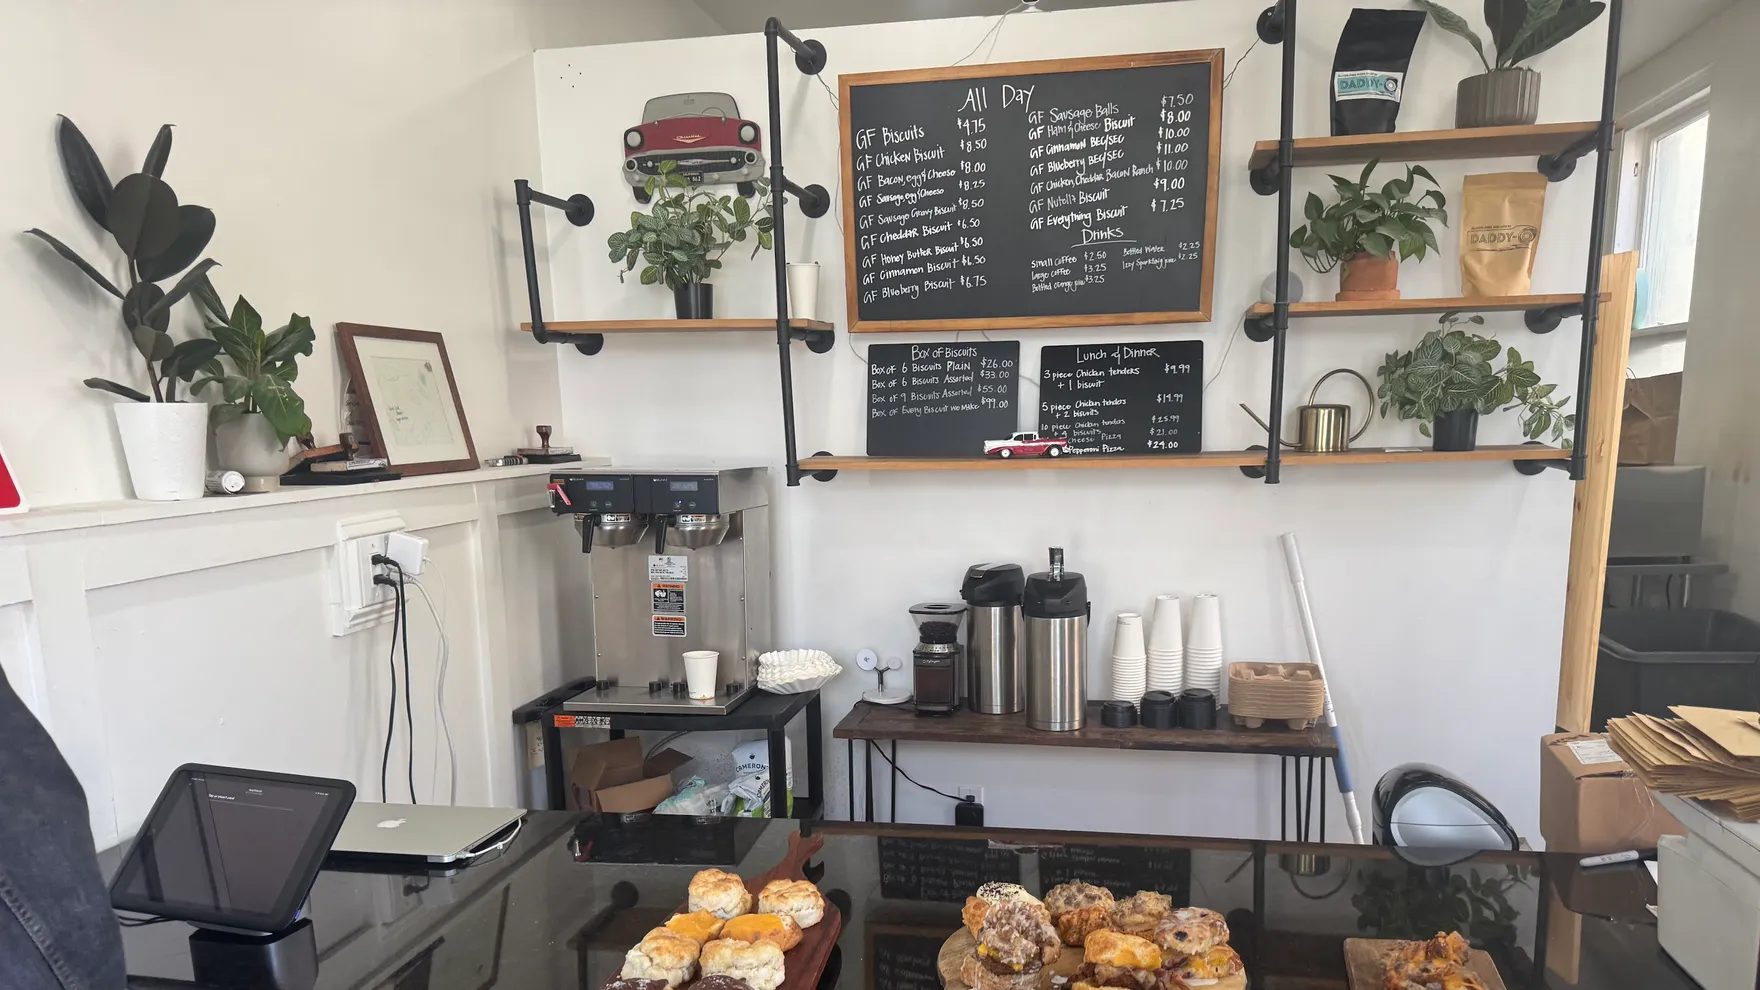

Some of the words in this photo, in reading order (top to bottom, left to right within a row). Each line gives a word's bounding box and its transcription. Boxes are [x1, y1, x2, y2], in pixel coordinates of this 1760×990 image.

[957, 86, 988, 112] All
[1002, 84, 1035, 113] Day
[1028, 110, 1045, 125] GF
[1050, 107, 1093, 124] Sausage
[1095, 102, 1119, 119] Balls
[1161, 93, 1194, 108] $7.50
[856, 128, 876, 150] GF
[882, 124, 925, 147] Biscuits
[956, 117, 986, 136] $4.75
[1028, 125, 1045, 140] GF
[1047, 124, 1067, 138] Ham
[1074, 119, 1101, 133] Cheese
[1104, 113, 1135, 132] Biscuit
[1160, 108, 1191, 124] $8.00
[1029, 144, 1044, 159] GF
[1158, 126, 1190, 140] $10.00
[856, 154, 873, 172] GF
[913, 144, 945, 164] Biscuit
[959, 138, 987, 153] $8.50
[1030, 162, 1044, 177] GF
[1047, 158, 1086, 175] Blueberry
[1156, 142, 1188, 155] $11.00
[857, 175, 873, 192] GF
[960, 160, 986, 174] $8.00
[1030, 181, 1044, 195] GF
[1132, 162, 1154, 177] Ranch
[1155, 157, 1188, 172] $10.00
[858, 195, 873, 208] GF
[958, 178, 986, 191] $8.25
[1028, 199, 1044, 214] GF
[1078, 187, 1110, 205] Biscuit
[1153, 177, 1185, 191] $9.00
[859, 215, 875, 230] GF
[877, 212, 910, 226] Sausage
[910, 207, 933, 220] Gravy
[934, 202, 957, 215] Biscuit
[958, 197, 985, 210] $8.50
[1030, 217, 1044, 230] GF
[1047, 211, 1092, 230] Everything
[1096, 205, 1128, 222] Biscuit
[1150, 197, 1185, 212] $7.25
[860, 233, 878, 250] GF
[922, 220, 953, 237] Biscuit
[957, 217, 981, 230] $6.50
[1081, 226, 1124, 245] Drinks
[862, 253, 877, 269] GF
[880, 253, 905, 267] Honey
[935, 241, 959, 255] Biscuit
[960, 236, 984, 249] $6.50
[1084, 250, 1107, 261] $2.50
[1178, 241, 1200, 251] $2.25
[1178, 252, 1198, 260] $2.25
[862, 272, 876, 285] GF
[879, 266, 924, 281] Cinnamon
[927, 258, 959, 274] Biscuit
[961, 254, 986, 266] $6.50
[1084, 263, 1107, 273] $3.25
[863, 290, 878, 304] GF
[882, 284, 920, 300] Blueberry
[924, 277, 956, 292] Biscuit
[960, 275, 987, 288] $6.75
[1084, 274, 1105, 284] $3.25
[911, 345, 930, 361] Box
[932, 346, 944, 358] of
[945, 346, 978, 358] Biscuits
[1076, 346, 1107, 364] Lunch
[871, 363, 885, 376] Box
[885, 364, 897, 375] of
[901, 362, 908, 374] 6
[912, 361, 942, 372] Biscuits
[946, 360, 971, 372] Plain
[980, 356, 1014, 369] $26.00
[1043, 369, 1051, 379] 3
[1052, 370, 1073, 381] piece
[1076, 368, 1105, 378] Chicken
[1108, 366, 1140, 376] tenders
[1164, 362, 1191, 374] $9.99
[871, 379, 886, 390] Box
[888, 379, 897, 388] of
[901, 376, 908, 387] 6
[912, 375, 940, 386] Biscuits
[943, 371, 974, 384] Assorted
[979, 370, 1010, 380] $33.00
[1077, 379, 1105, 390] biscuit
[871, 394, 886, 404] Box
[889, 393, 898, 403] of
[900, 393, 907, 402] 9
[911, 390, 941, 401] Biscuits
[941, 386, 973, 399] Assorted
[976, 383, 1008, 394] $55.00
[1042, 401, 1049, 412] 5
[1050, 403, 1072, 414] piece
[1075, 399, 1101, 409] Chicken
[1102, 398, 1127, 407] tenders
[1156, 393, 1184, 403] $14.99
[871, 408, 887, 419] Box
[889, 407, 898, 417] of
[901, 405, 922, 418] Every
[923, 404, 949, 415] Biscuit
[981, 397, 1009, 410] $99.00
[1073, 408, 1099, 419] biscuits
[1051, 422, 1072, 432] piece
[1074, 421, 1100, 429] Chicken
[1073, 428, 1102, 437] biscuits
[1101, 432, 1122, 441] Pizza
[1149, 427, 1178, 436] $21.00
[1068, 444, 1100, 455] Pepperoni
[1102, 443, 1125, 453] Pizza
[1147, 439, 1179, 450] $24.00
